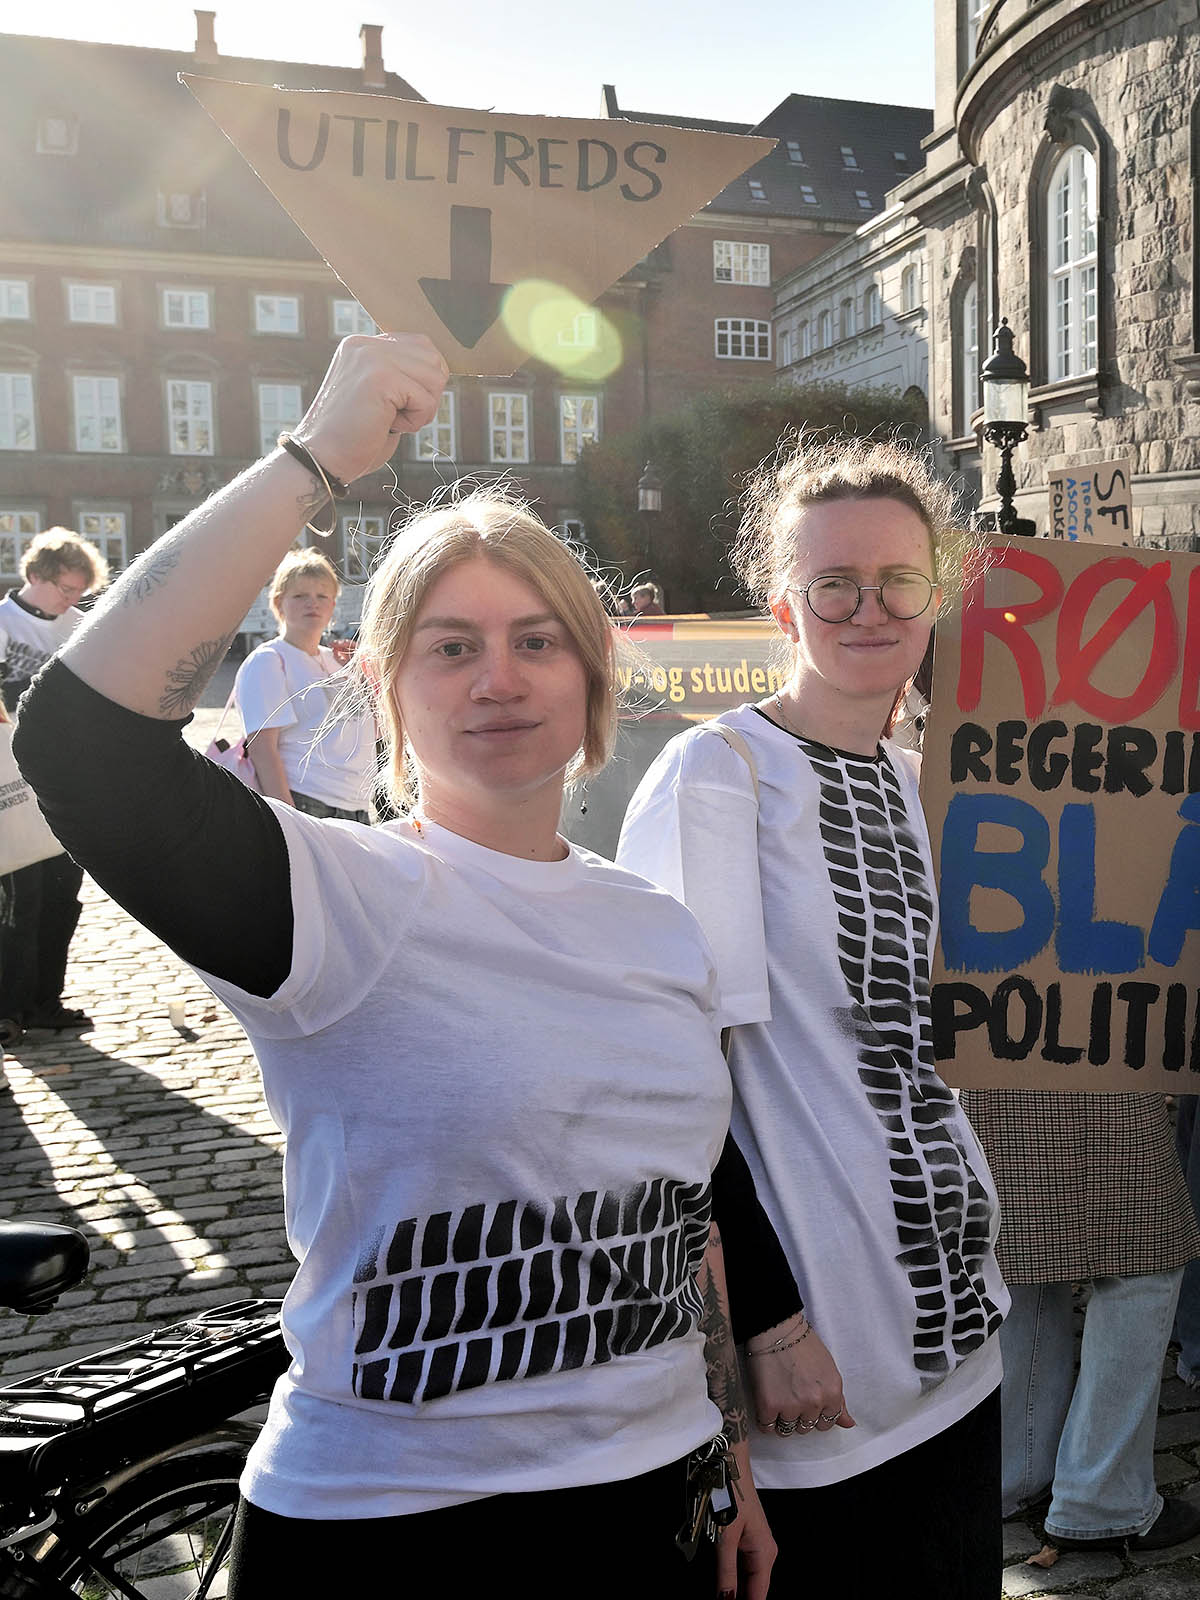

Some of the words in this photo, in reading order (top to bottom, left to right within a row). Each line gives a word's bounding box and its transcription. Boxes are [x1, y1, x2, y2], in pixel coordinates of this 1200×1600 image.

[277, 108, 668, 202] UTILFREDS
[1093, 468, 1130, 530] SF
[652, 666, 686, 703] og
